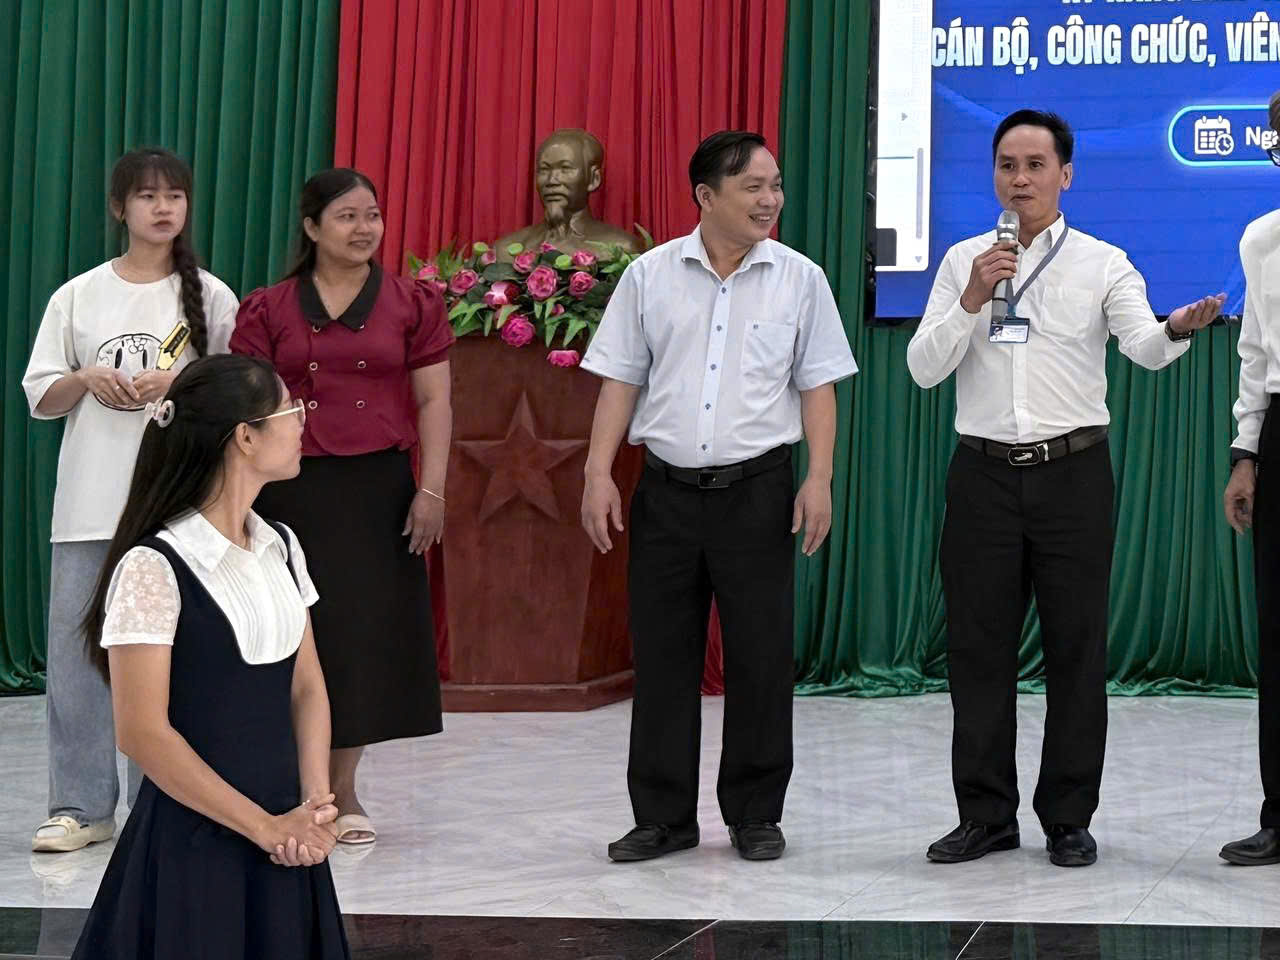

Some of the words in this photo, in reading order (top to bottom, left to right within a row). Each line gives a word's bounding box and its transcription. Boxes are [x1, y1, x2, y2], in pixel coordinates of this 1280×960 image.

[931, 17, 984, 67] CÁN
[993, 17, 1039, 75] BỘ,
[1047, 14, 1122, 65] CÔNG
[1130, 16, 1217, 67] CHỨC,
